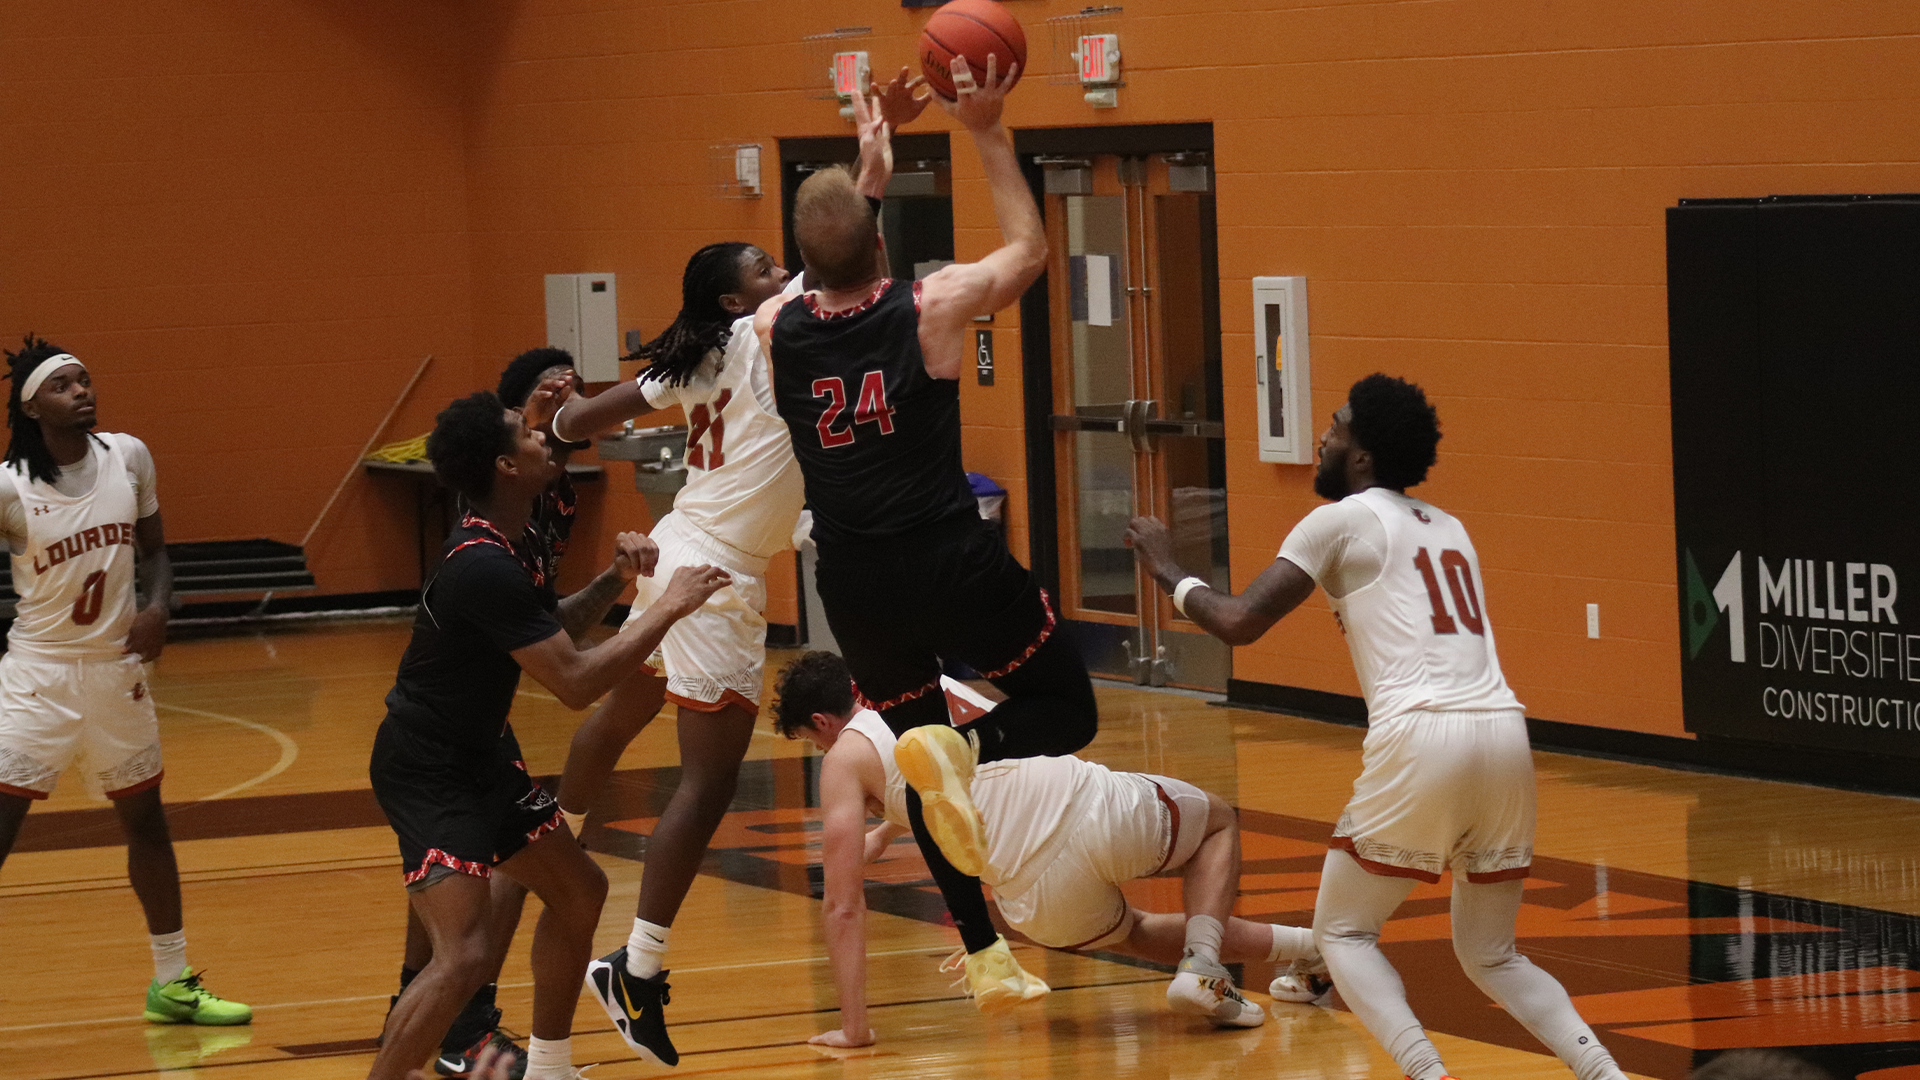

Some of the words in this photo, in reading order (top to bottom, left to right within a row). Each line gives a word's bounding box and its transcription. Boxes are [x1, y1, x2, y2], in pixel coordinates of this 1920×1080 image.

[811, 369, 897, 449] 24
[71, 569, 107, 626] 0
[1412, 546, 1485, 638] 10
[1757, 556, 1899, 625] MILLER
